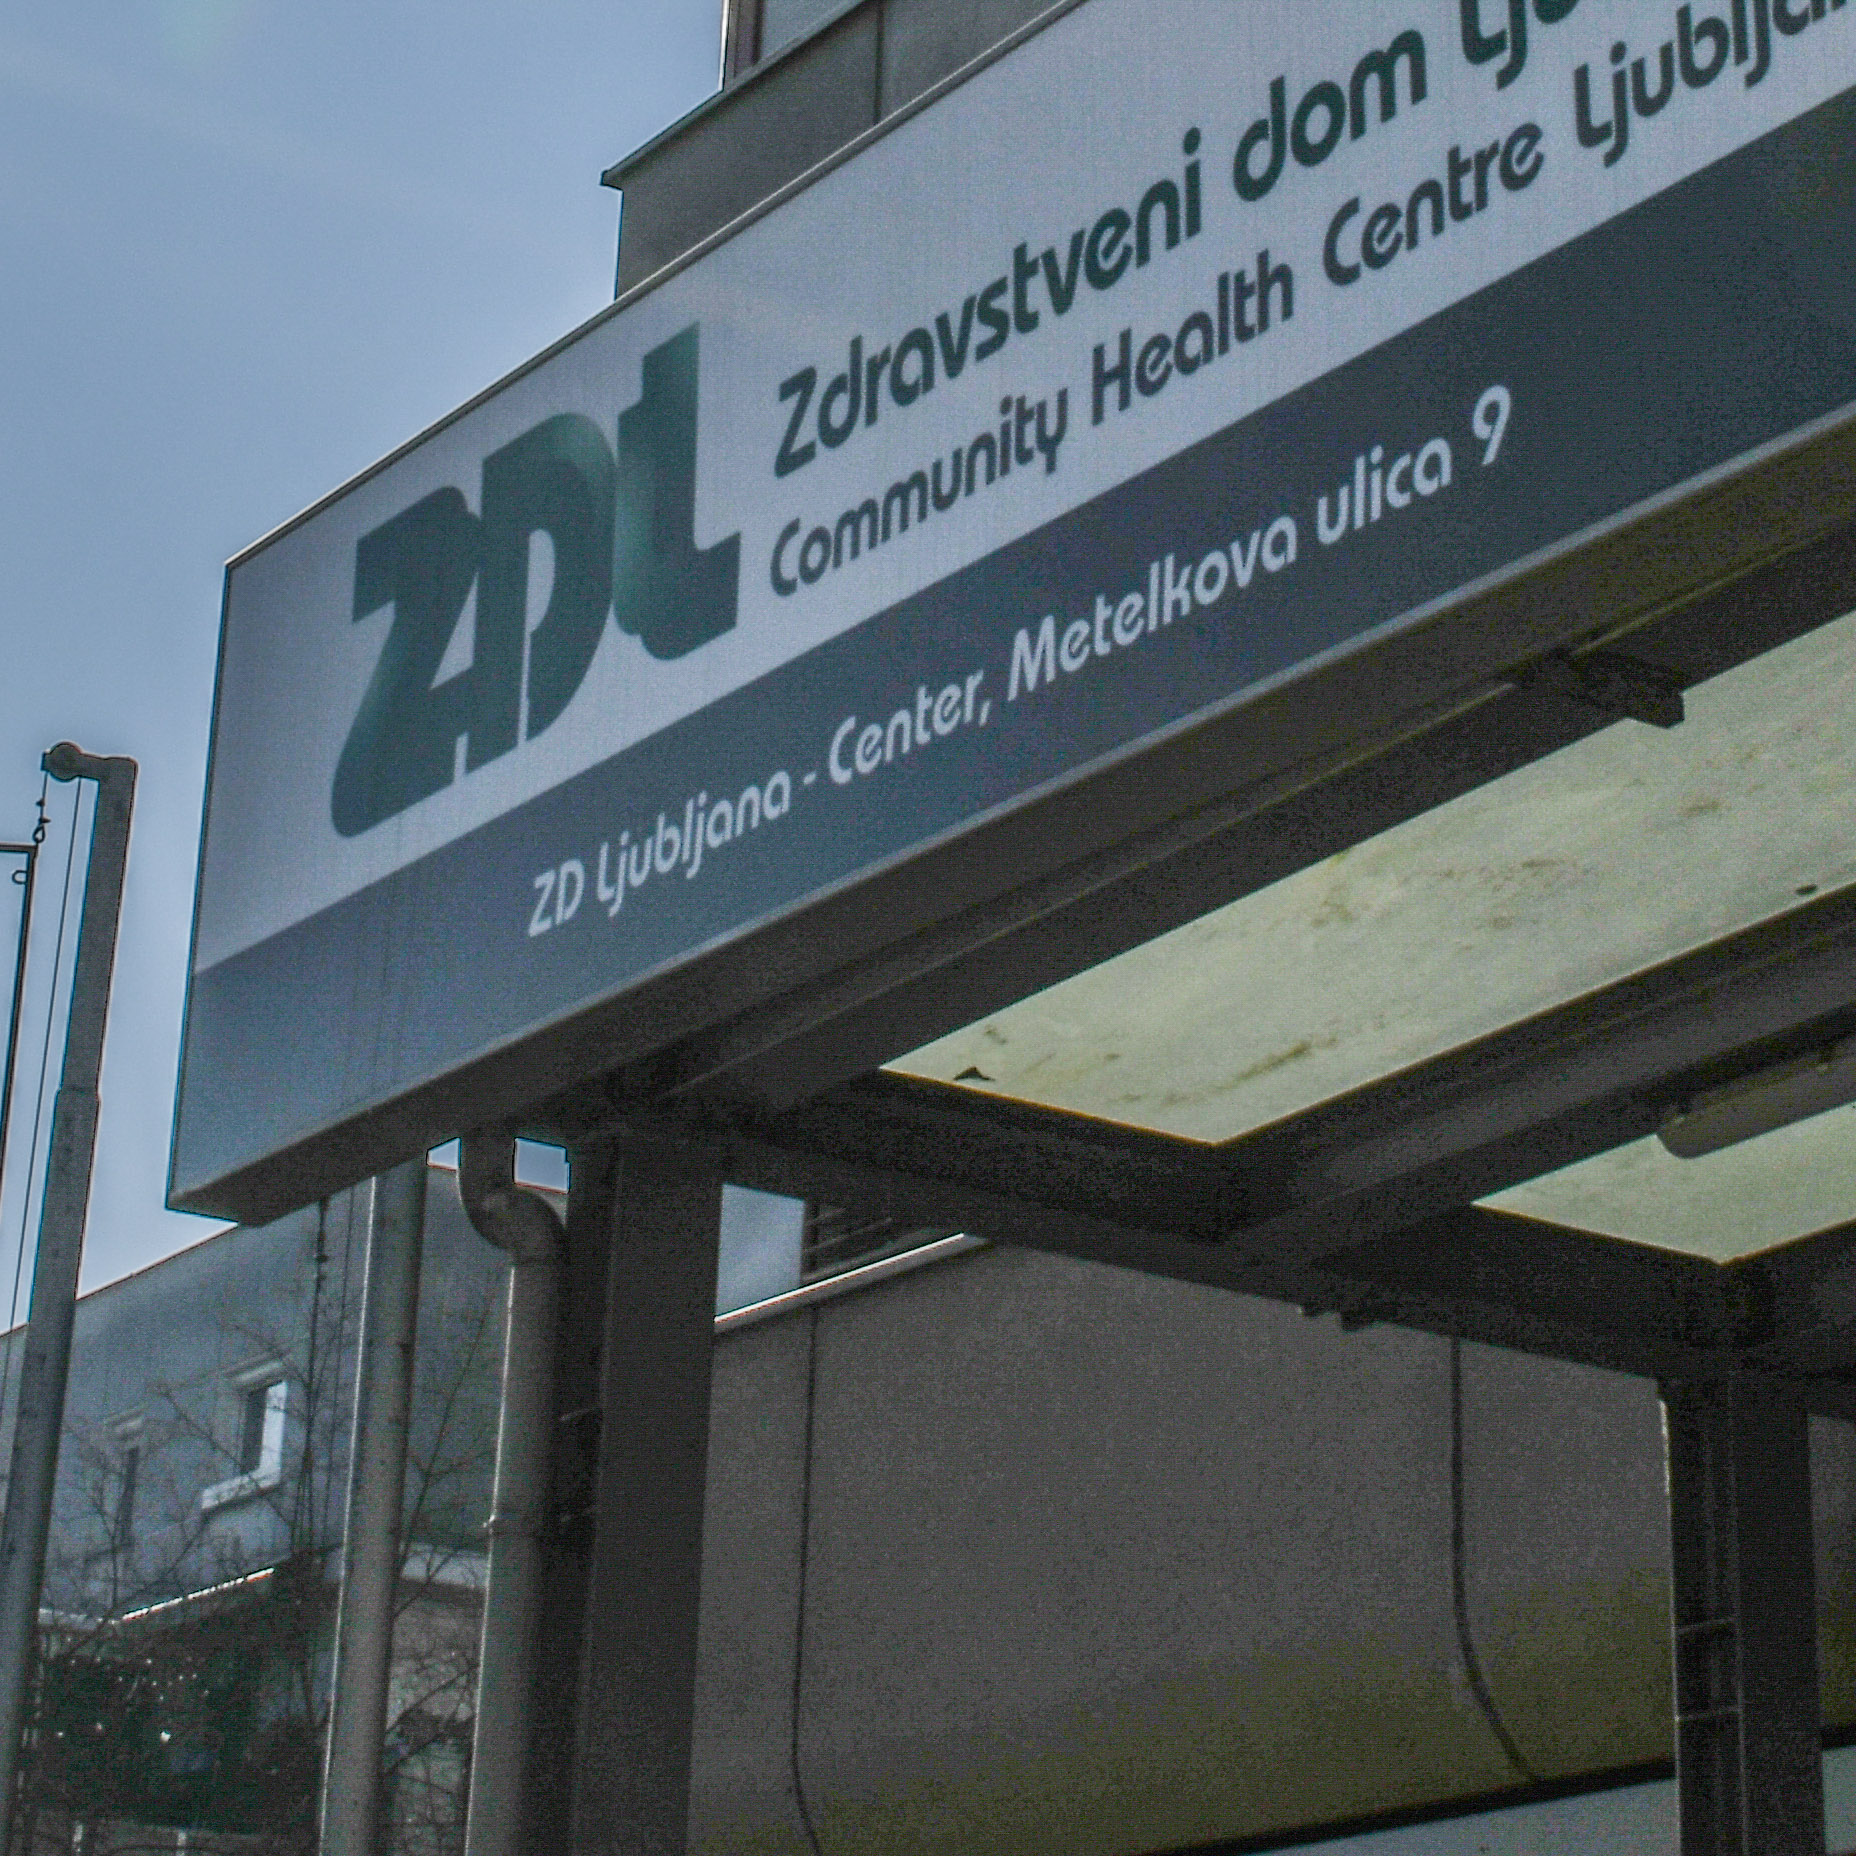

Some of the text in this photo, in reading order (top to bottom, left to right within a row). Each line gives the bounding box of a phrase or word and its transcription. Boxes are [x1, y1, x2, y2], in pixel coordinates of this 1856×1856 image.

[769, 387, 1069, 599] Community
[1091, 248, 1295, 427] Health
[1321, 121, 1546, 288] Centre
[773, 125, 1203, 480] Zdravstveni
[1231, 27, 1429, 204] dom
[331, 320, 742, 838] ZDL
[526, 858, 586, 939] ZD
[595, 769, 793, 919] Ljubljana
[827, 670, 992, 786] Center,
[1006, 515, 1299, 702] Metelkova
[1315, 436, 1454, 546] ulica
[1470, 383, 1513, 467] 9
